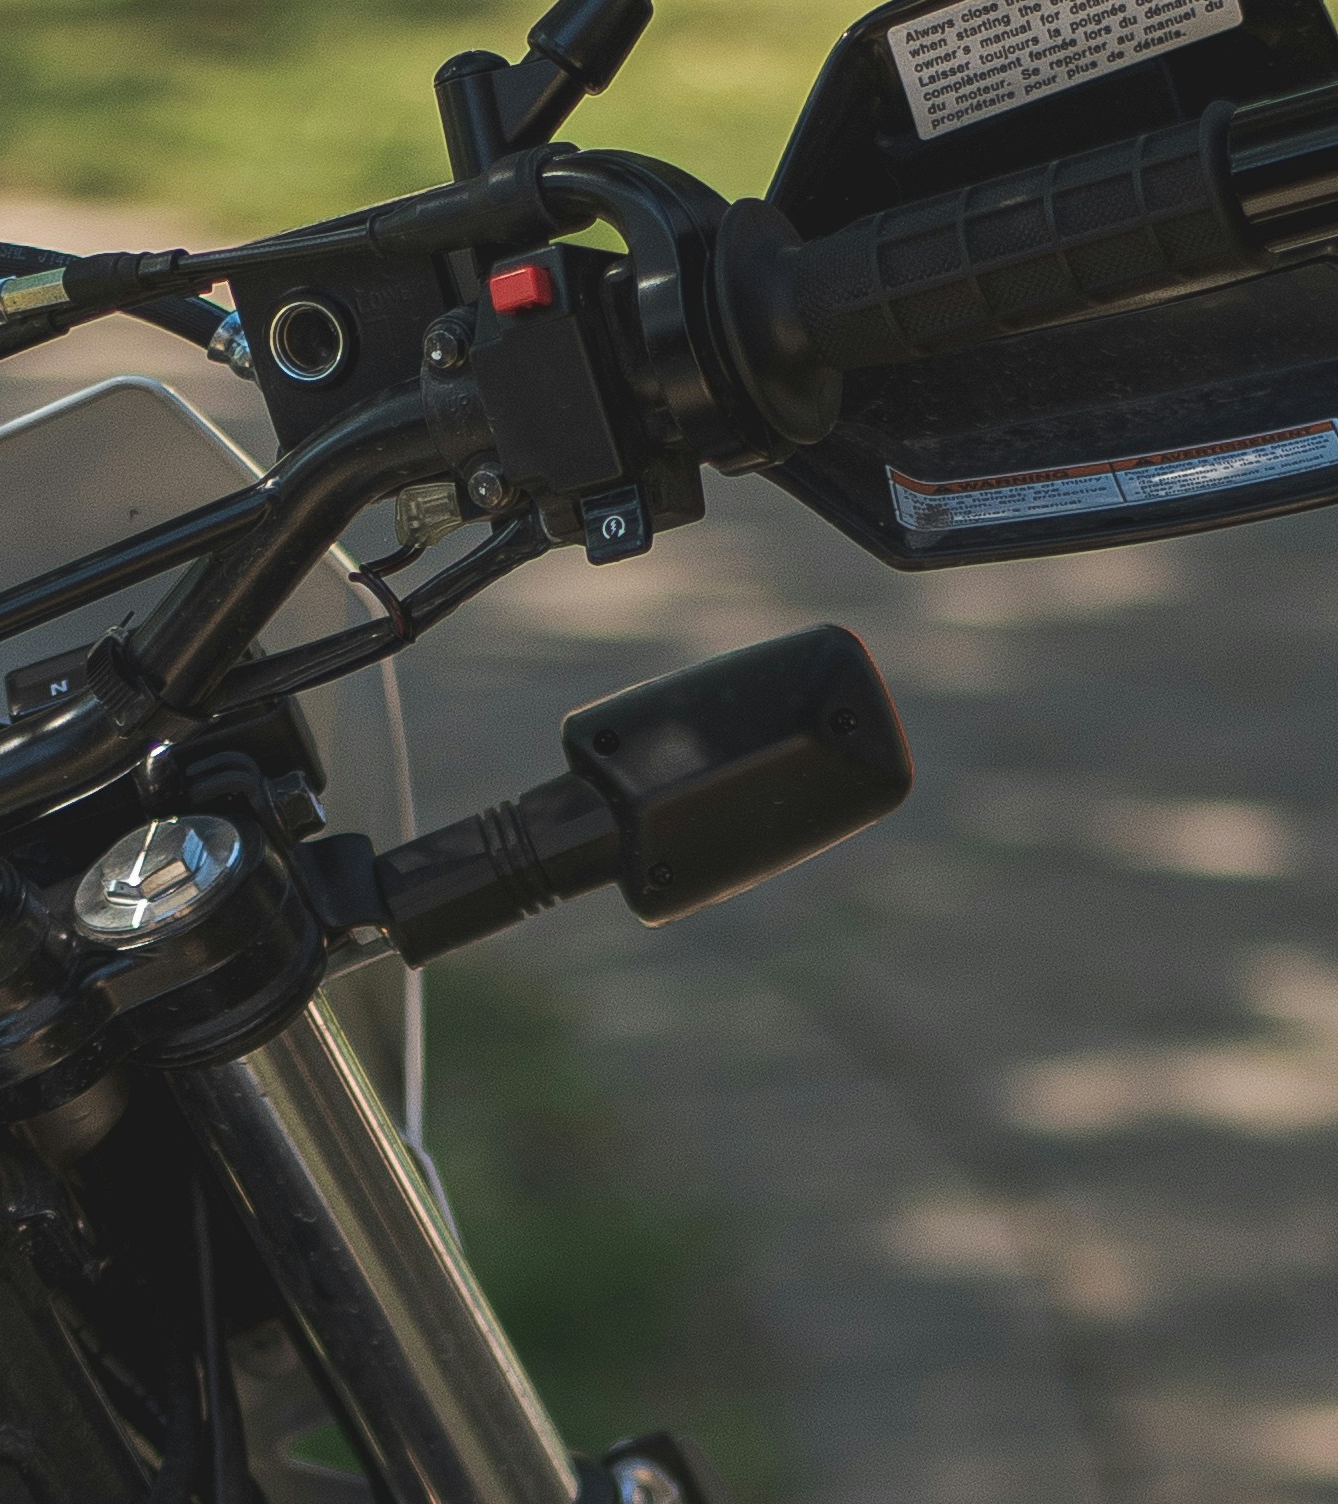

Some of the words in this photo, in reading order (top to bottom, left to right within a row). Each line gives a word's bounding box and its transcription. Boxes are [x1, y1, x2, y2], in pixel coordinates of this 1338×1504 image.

[906, 18, 955, 45] Always
[961, 2, 999, 23] close
[909, 38, 948, 59] when
[956, 14, 1011, 41] starting
[1018, 2, 1043, 18] the
[914, 45, 971, 73] owner's
[979, 19, 1032, 49] manual
[1039, 11, 1060, 26] for
[918, 61, 970, 88] Laisser
[979, 36, 1040, 65] toujours
[1047, 27, 1065, 42] la
[1069, 3, 1127, 34] poignée
[923, 57, 1023, 102] complètement
[1028, 38, 1078, 63] fermée
[1083, 25, 1112, 42] lors
[1119, 15, 1138, 29] du
[927, 101, 946, 115] du
[955, 79, 1012, 105] moteur.
[1021, 67, 1040, 80] Se
[1049, 41, 1108, 70] reporter
[1117, 32, 1135, 45] au
[1143, 7, 1196, 36] manuel
[1204, 0, 1224, 13] du
[931, 91, 1015, 130] propriétaire
[1024, 74, 1058, 96] pour
[1066, 60, 1098, 80] plus
[1106, 50, 1125, 63] de
[1133, 29, 1187, 53] détails.
[958, 469, 1069, 492] WARNING
[50, 679, 68, 697] N
